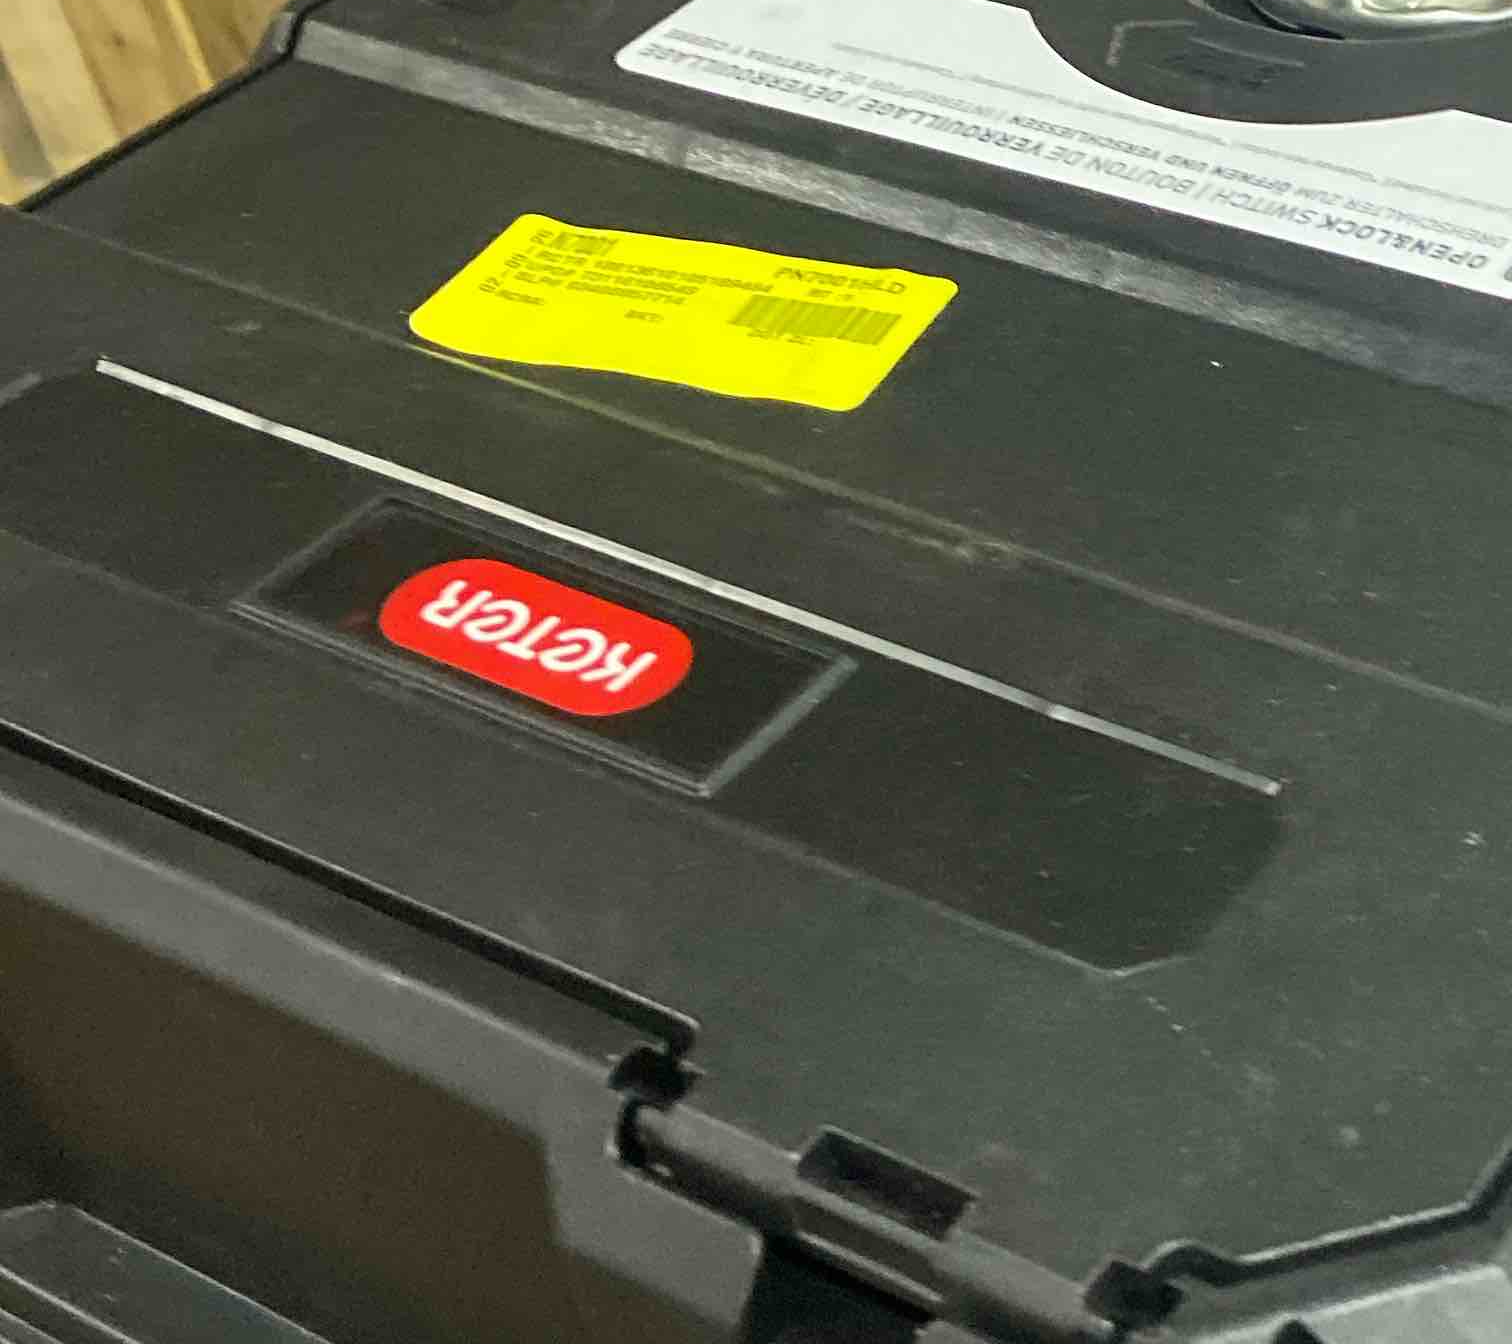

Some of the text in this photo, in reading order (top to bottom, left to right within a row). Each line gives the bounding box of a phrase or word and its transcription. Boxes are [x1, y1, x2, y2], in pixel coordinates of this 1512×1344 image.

[854, 97, 1052, 159] VERROUILLAGE
[1041, 144, 1090, 168] DE
[1081, 154, 1199, 196] BOUTON
[1161, 152, 1214, 175] UND
[1209, 186, 1323, 228] SWITCH
[1315, 213, 1495, 272] OPEN&LOCK
